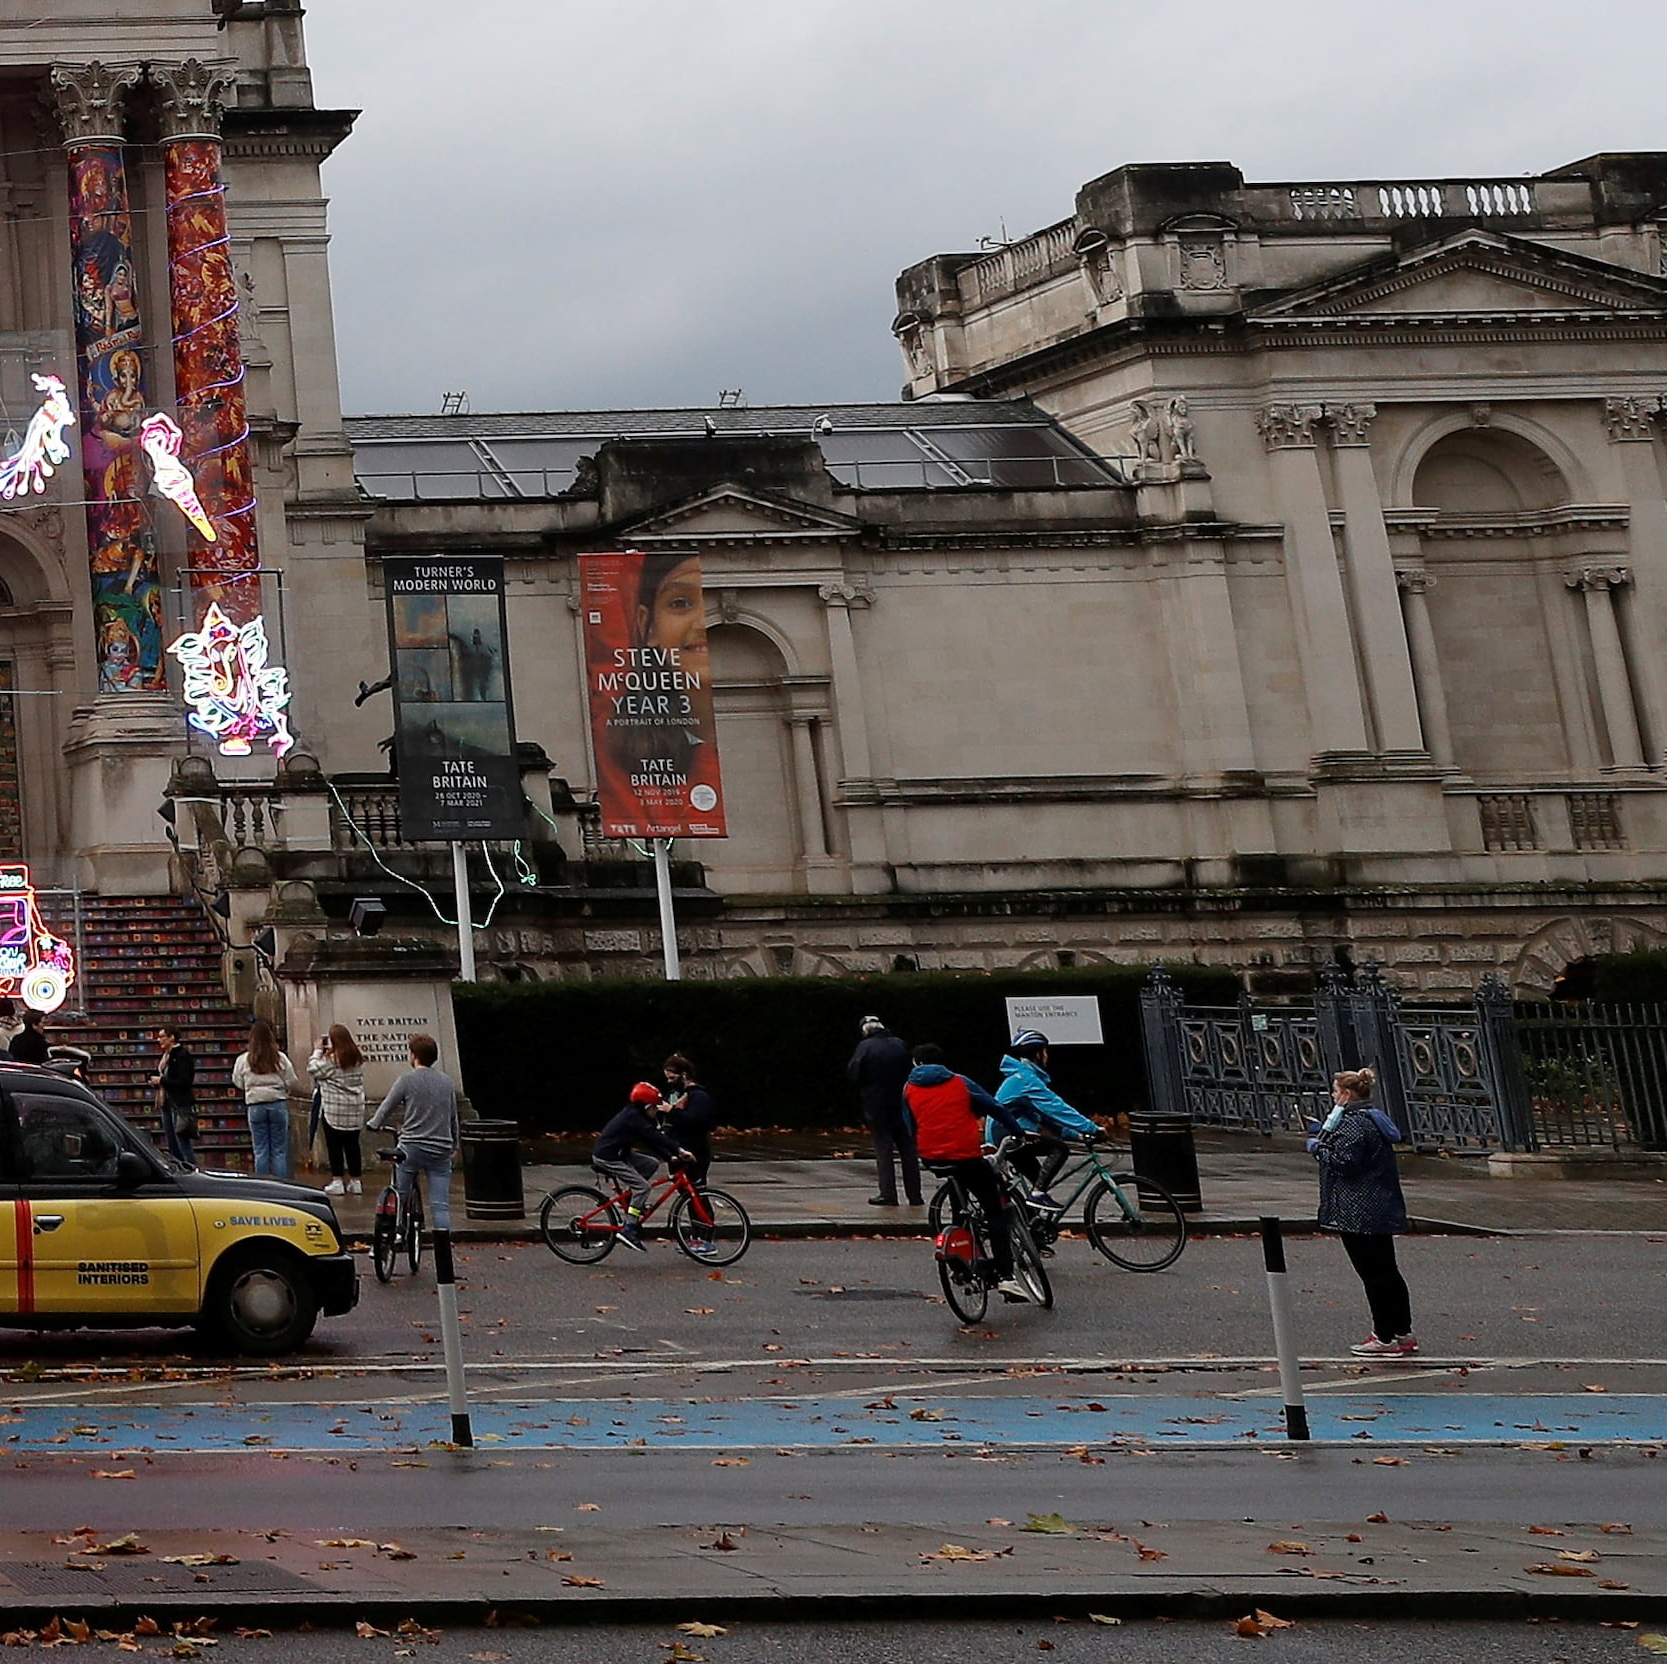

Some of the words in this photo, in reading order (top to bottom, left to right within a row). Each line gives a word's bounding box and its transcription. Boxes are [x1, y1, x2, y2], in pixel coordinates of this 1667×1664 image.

[413, 566, 475, 577] TURNER'S
[393, 579, 448, 591] MODERN
[451, 579, 496, 591] WORLD
[613, 648, 681, 667] STEVE
[598, 671, 701, 691] McQUEEN
[611, 696, 669, 715] YEAR
[679, 695, 691, 714] 3
[606, 719, 613, 727] A
[614, 718, 652, 727] PORTRAIT
[654, 718, 664, 726] OF
[667, 717, 700, 725] LONDON
[442, 761, 475, 774] TATE
[640, 758, 674, 772] TATE
[432, 776, 487, 788] BRITAIN
[630, 774, 687, 786] BRITAIN
[446, 792, 460, 800] OCT
[644, 788, 661, 796] NOV
[647, 798, 662, 806] MAY
[646, 824, 681, 834] Artangel
[357, 1018, 385, 1026] TATE
[387, 1018, 428, 1026] BRITAIN
[357, 1034, 379, 1042] THE
[229, 1216, 261, 1226] SAVE
[263, 1217, 297, 1227] LIVES
[77, 1262, 149, 1273] SANITISED
[78, 1274, 149, 1285] INTERIORS
